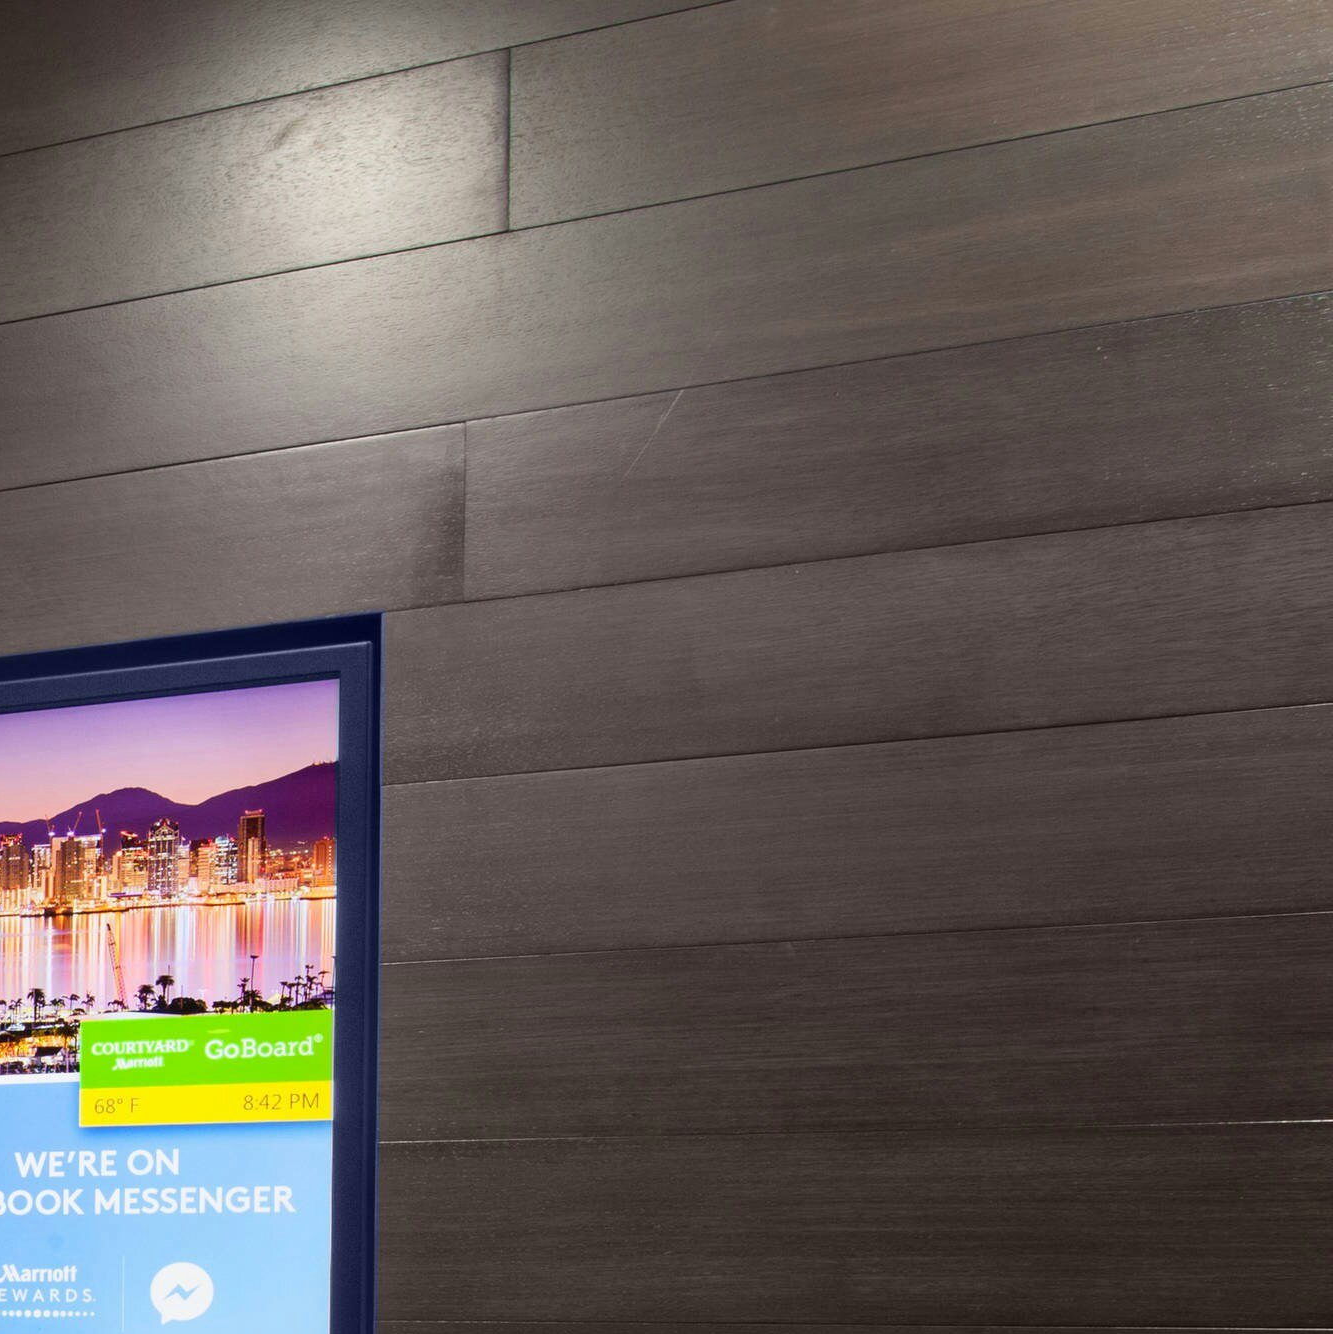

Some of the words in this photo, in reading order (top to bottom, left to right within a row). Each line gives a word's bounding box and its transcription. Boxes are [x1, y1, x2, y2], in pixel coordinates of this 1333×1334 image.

[112, 1056, 164, 1071] Marriott
[94, 1098, 123, 1114] 68°
[130, 1098, 140, 1113] F
[243, 1094, 282, 1111] 8:42
[290, 1092, 320, 1109] PM
[14, 1150, 118, 1178] WE'RE
[126, 1148, 180, 1176] ON
[94, 1185, 296, 1215] MESSENGER
